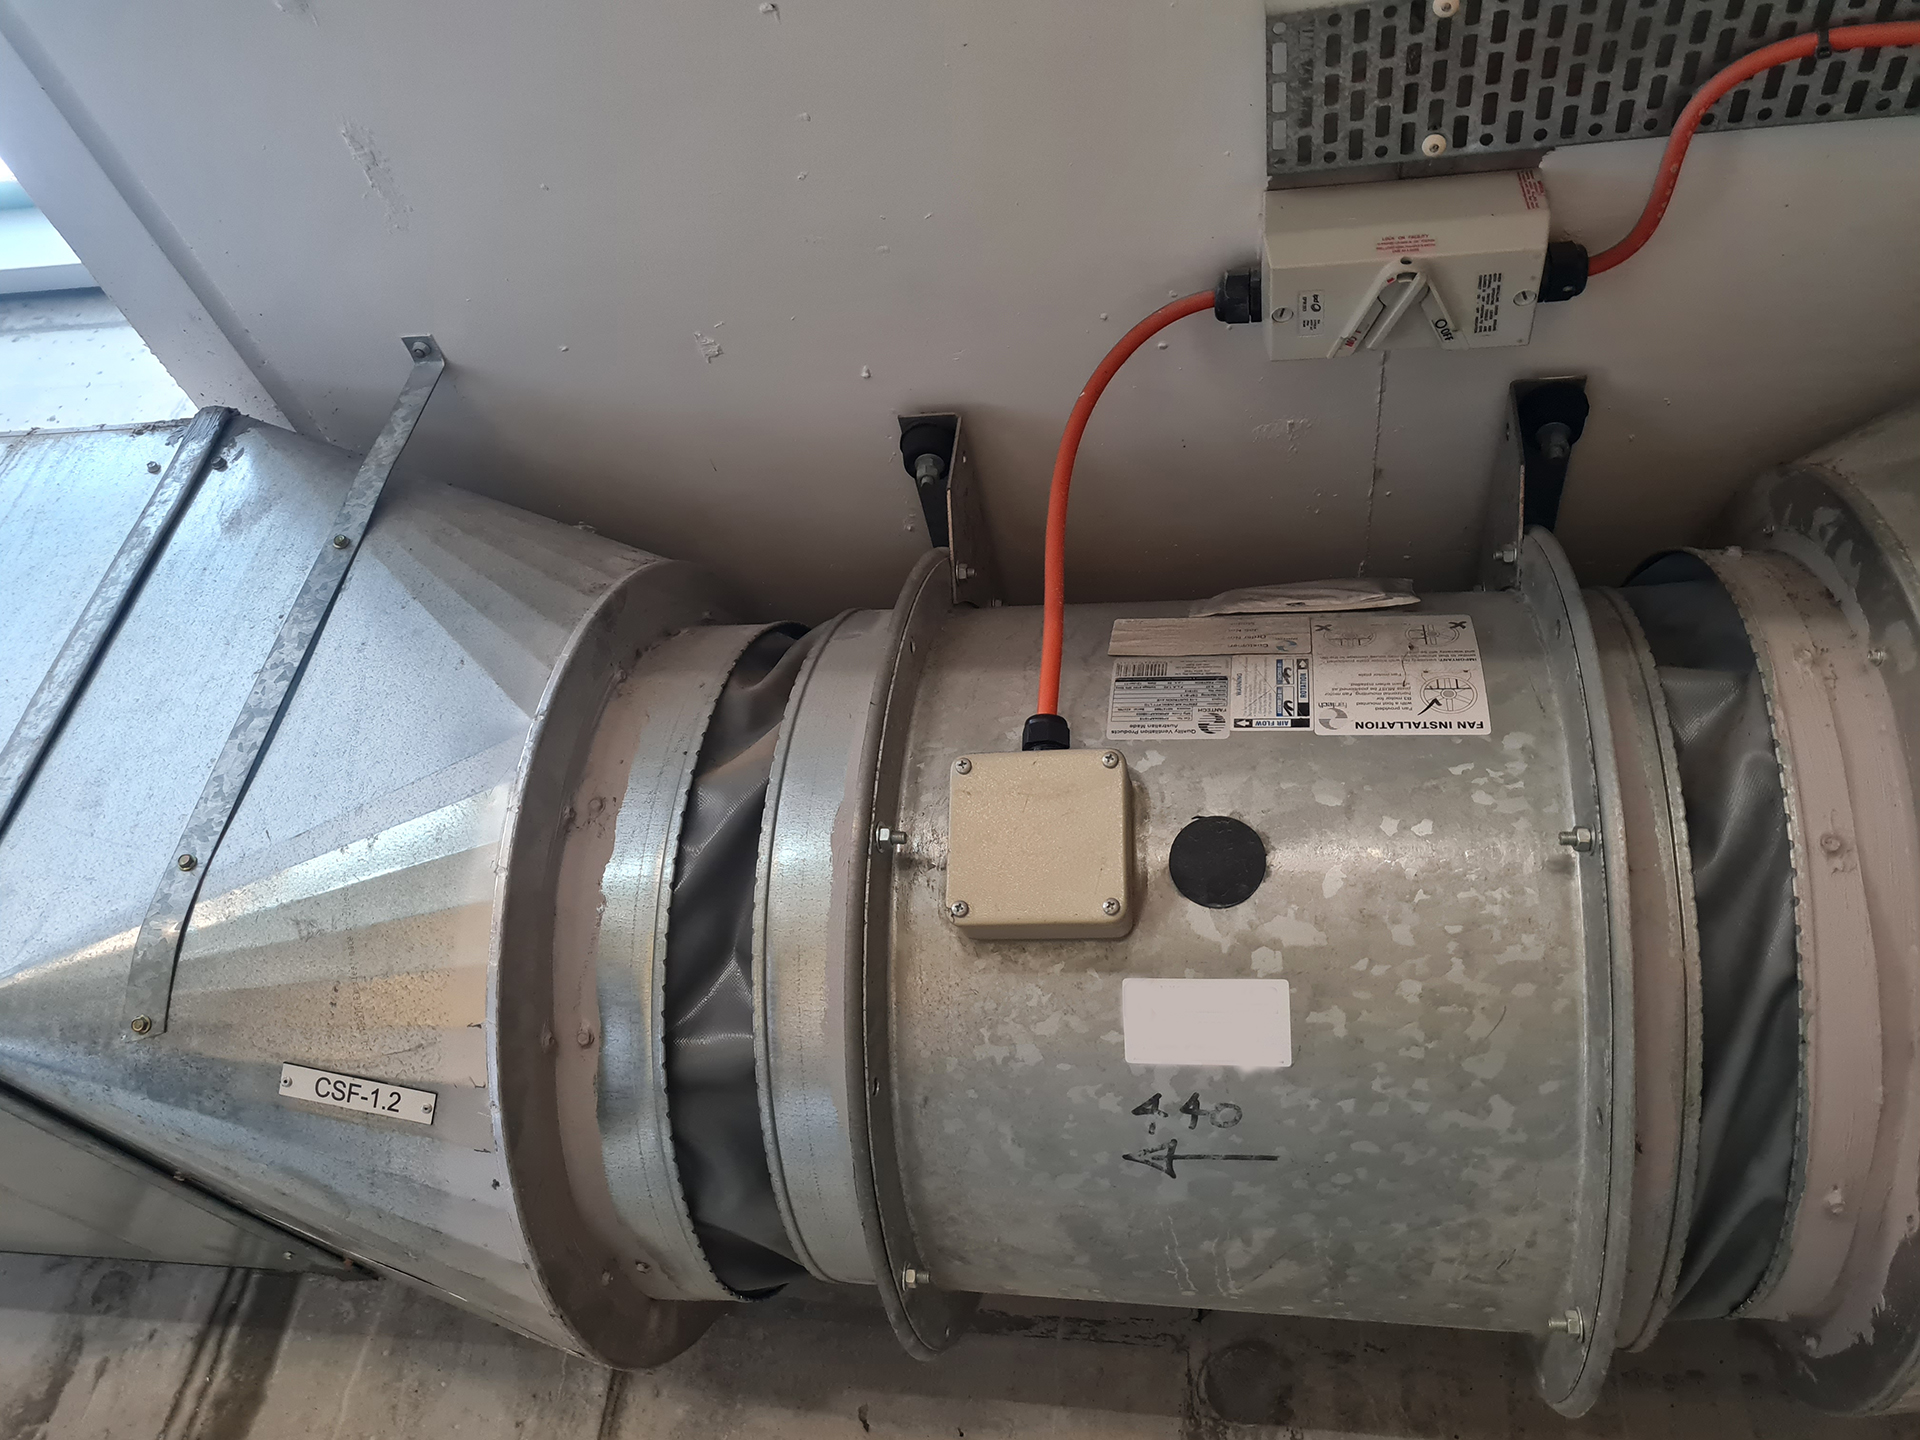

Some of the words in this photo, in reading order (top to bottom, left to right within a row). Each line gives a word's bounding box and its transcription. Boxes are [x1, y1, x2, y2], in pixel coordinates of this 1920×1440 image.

[1440, 327, 1454, 341] OFF
[1299, 672, 1307, 699] ROTATION
[1355, 721, 1452, 730] INSTALLATION
[1457, 721, 1484, 729] FAN
[315, 1077, 401, 1113] CSF-1.2
